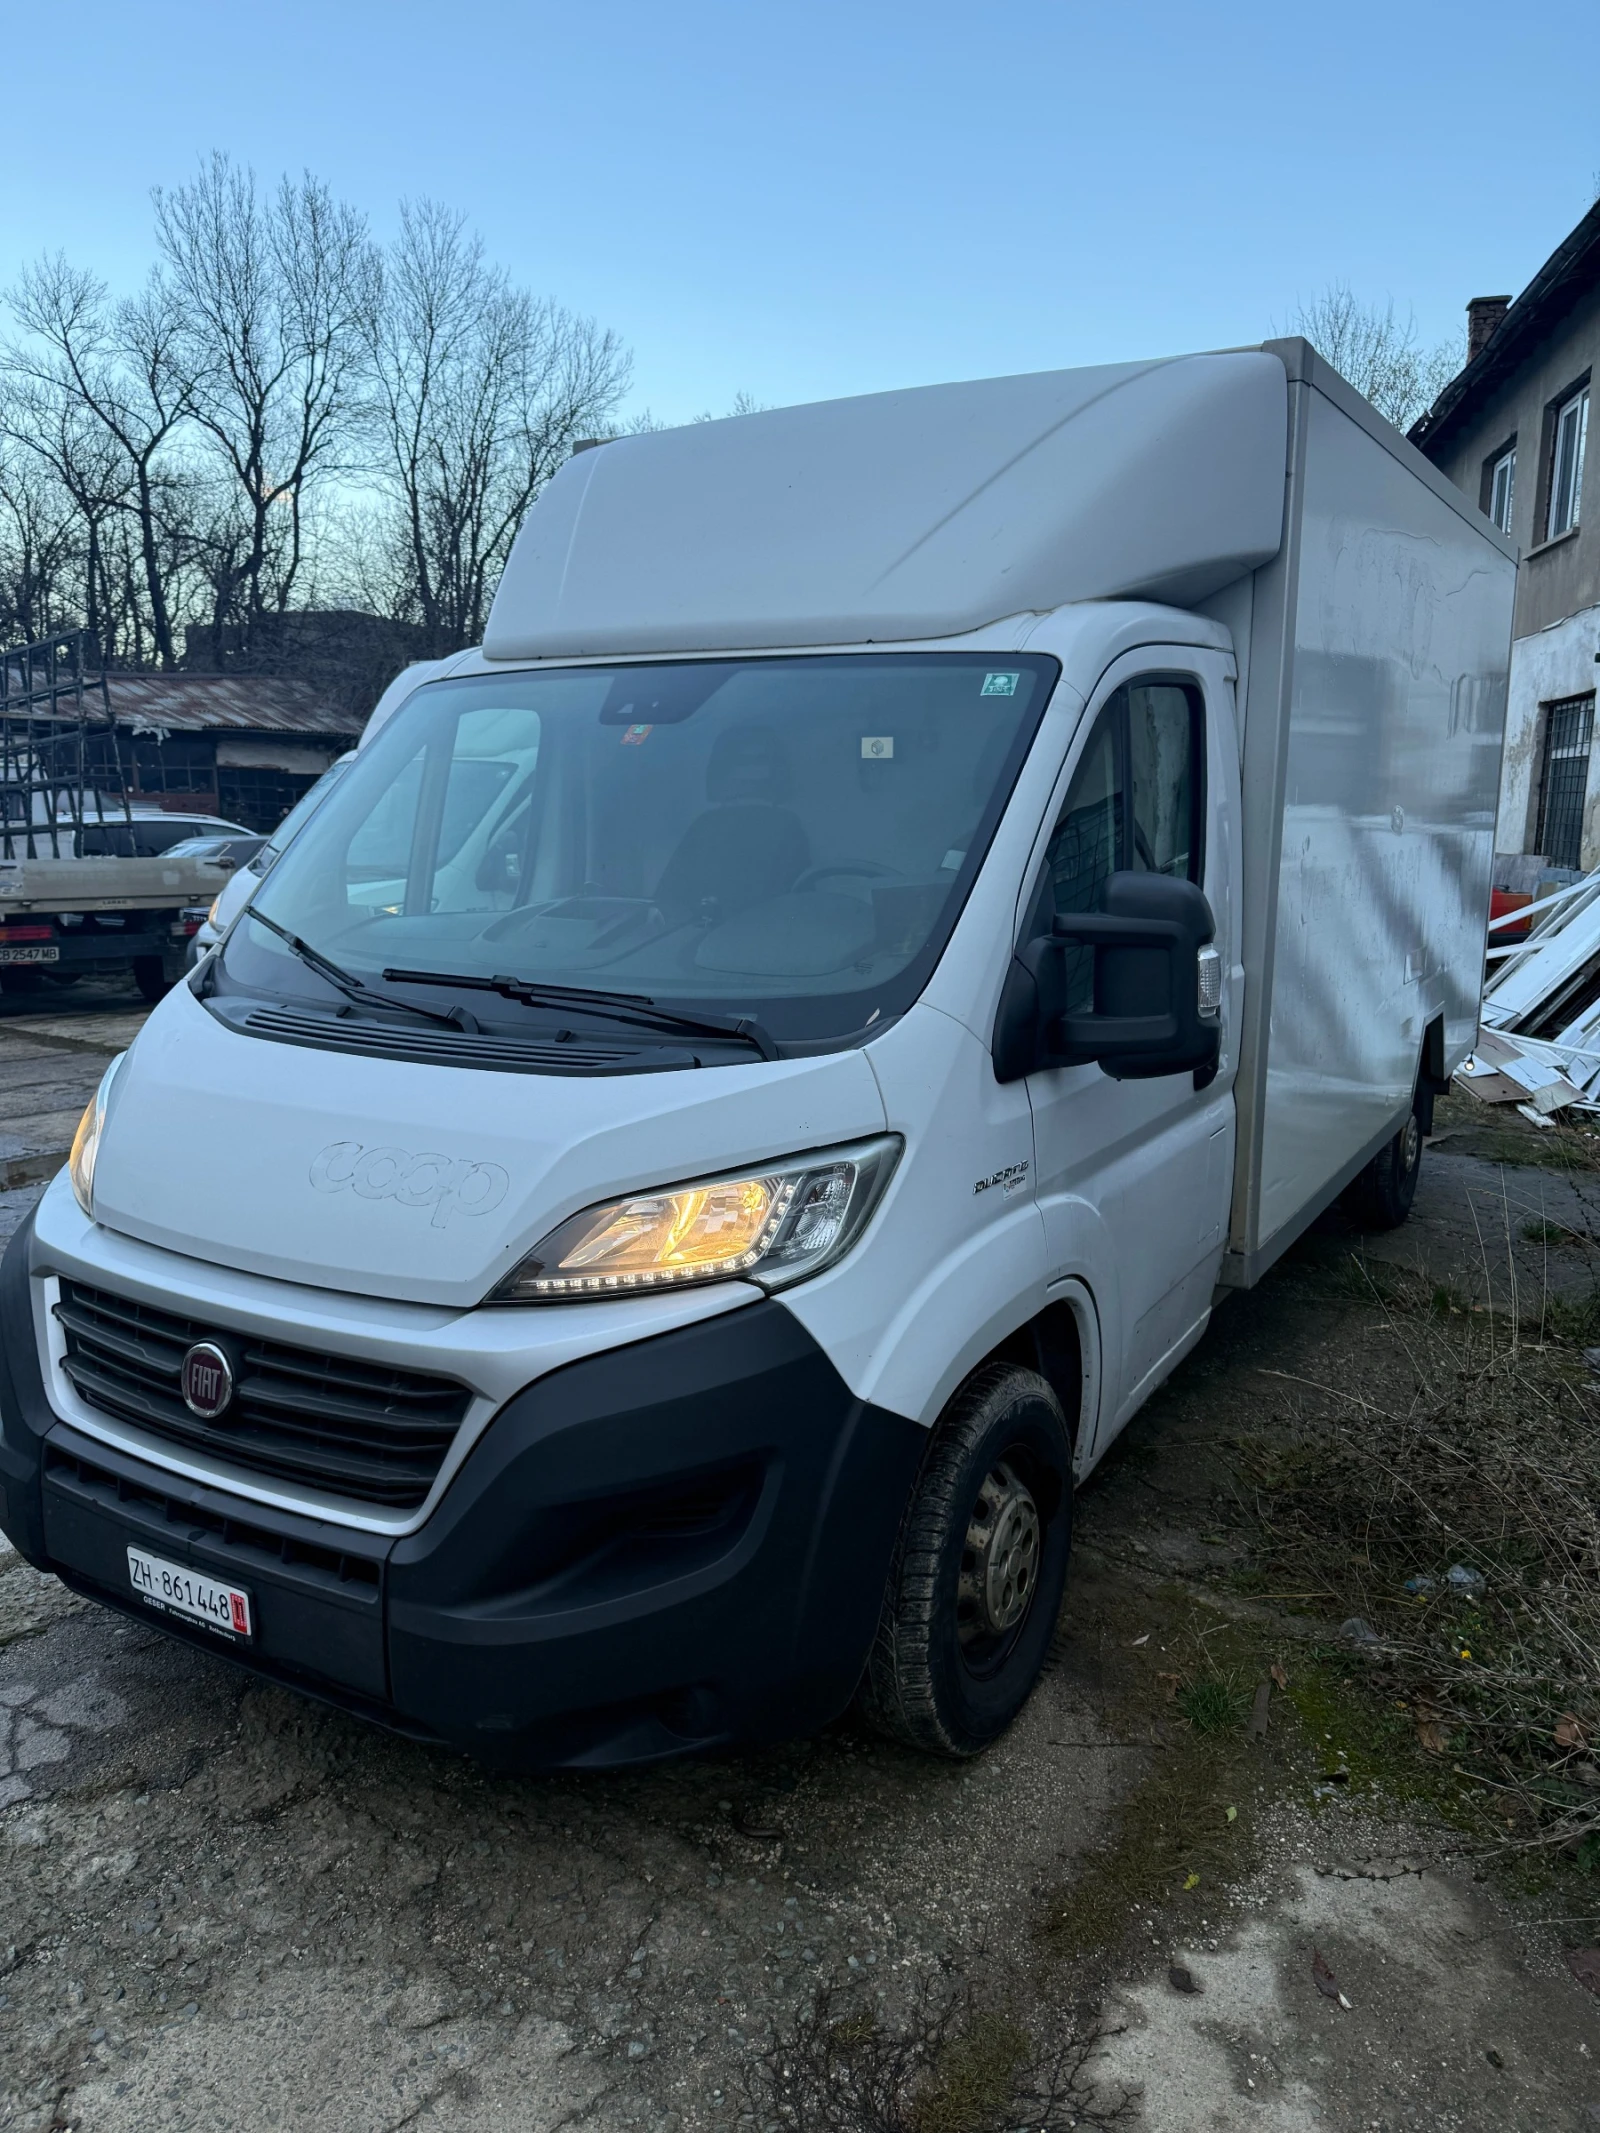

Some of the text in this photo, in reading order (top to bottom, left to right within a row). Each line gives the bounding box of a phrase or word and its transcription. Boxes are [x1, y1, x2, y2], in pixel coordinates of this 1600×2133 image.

[12, 949, 40, 960] 2547
[41, 948, 57, 959] MB
[308, 1141, 510, 1229] coop
[972, 1160, 1029, 1195] DUCATO
[191, 1363, 221, 1401] FIAT
